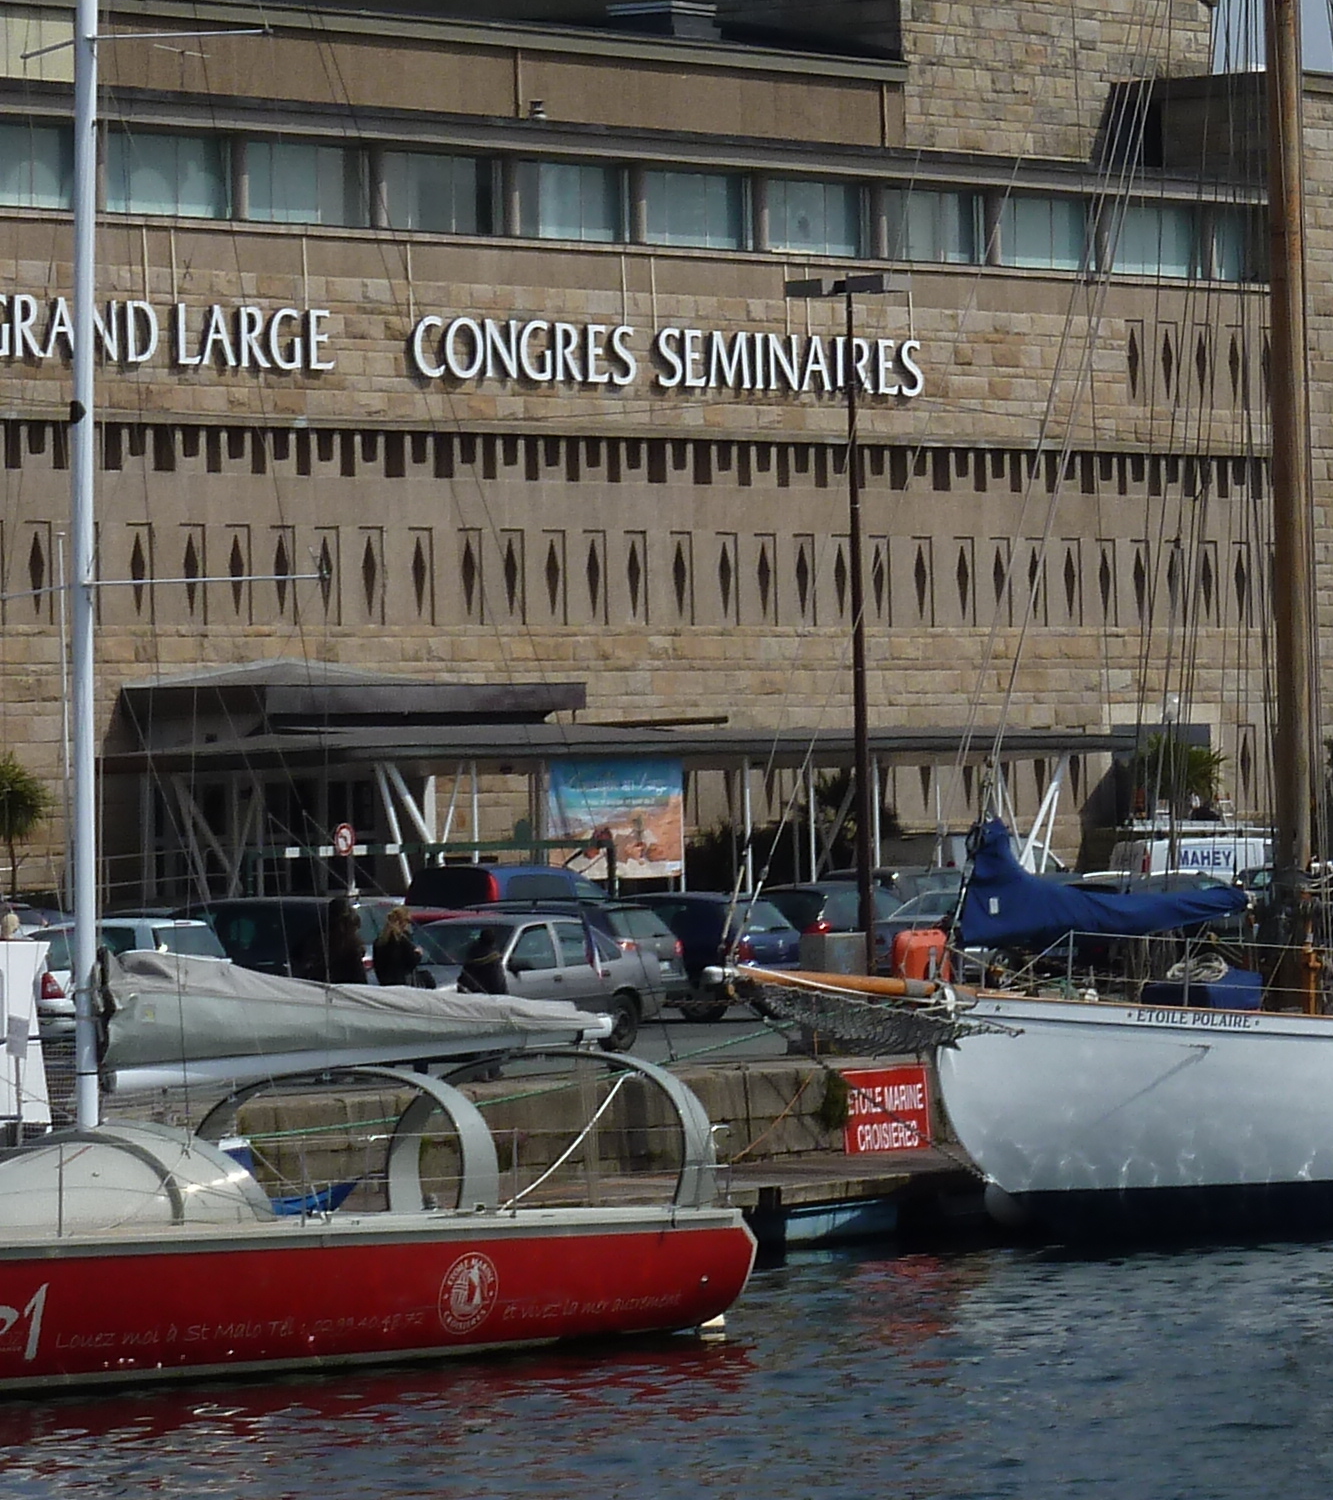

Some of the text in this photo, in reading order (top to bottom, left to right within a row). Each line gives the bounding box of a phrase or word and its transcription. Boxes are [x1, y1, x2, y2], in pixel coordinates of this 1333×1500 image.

[178, 302, 335, 371] LARGE
[413, 315, 924, 398] CONGRES SEMINAIRES
[1179, 850, 1231, 867] MAHEY
[1136, 1009, 1252, 1029] ETOILE POLAIRE
[847, 1083, 923, 1115] ETOILE MARINE
[857, 1120, 919, 1151] CROISIERES
[184, 1324, 210, 1342] St
[213, 1320, 262, 1340] Malo
